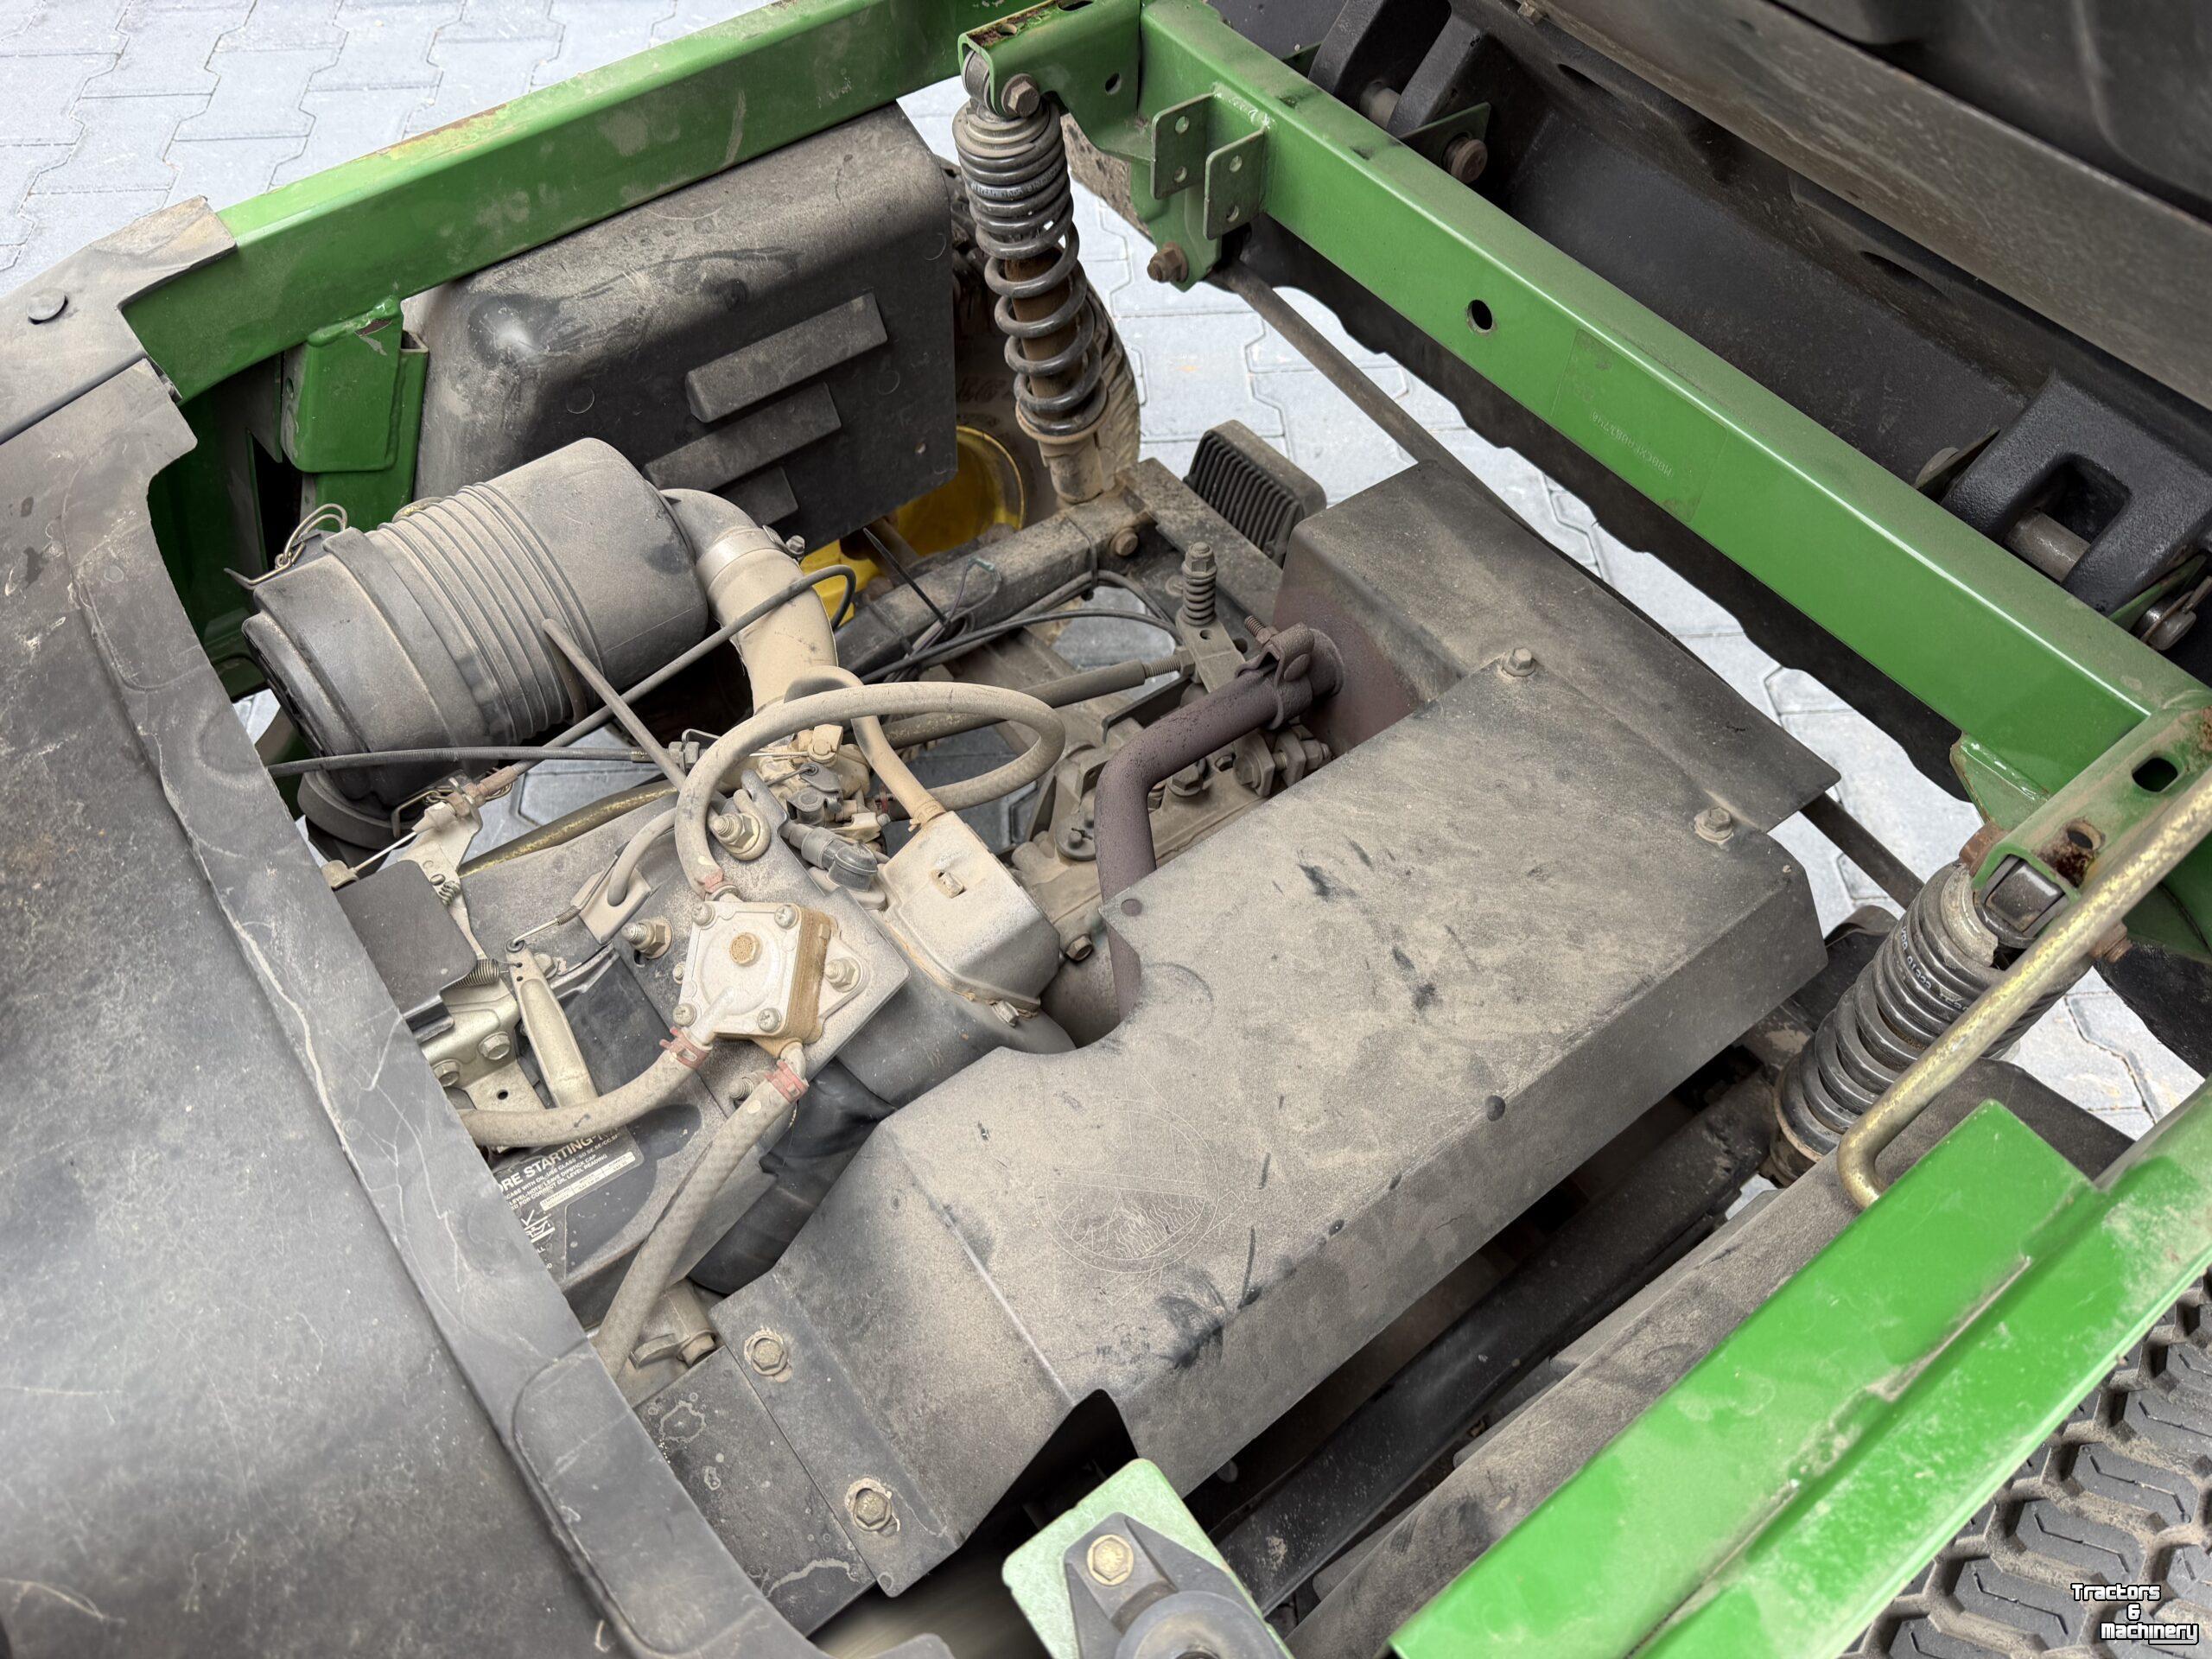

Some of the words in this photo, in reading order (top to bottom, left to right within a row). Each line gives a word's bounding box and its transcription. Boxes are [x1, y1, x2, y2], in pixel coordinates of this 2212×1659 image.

[585, 1154, 597, 1164] CAP
[566, 1167, 584, 1179] LEVEL
[583, 1154, 608, 1170] READING
[522, 1180, 536, 1191] WITH
